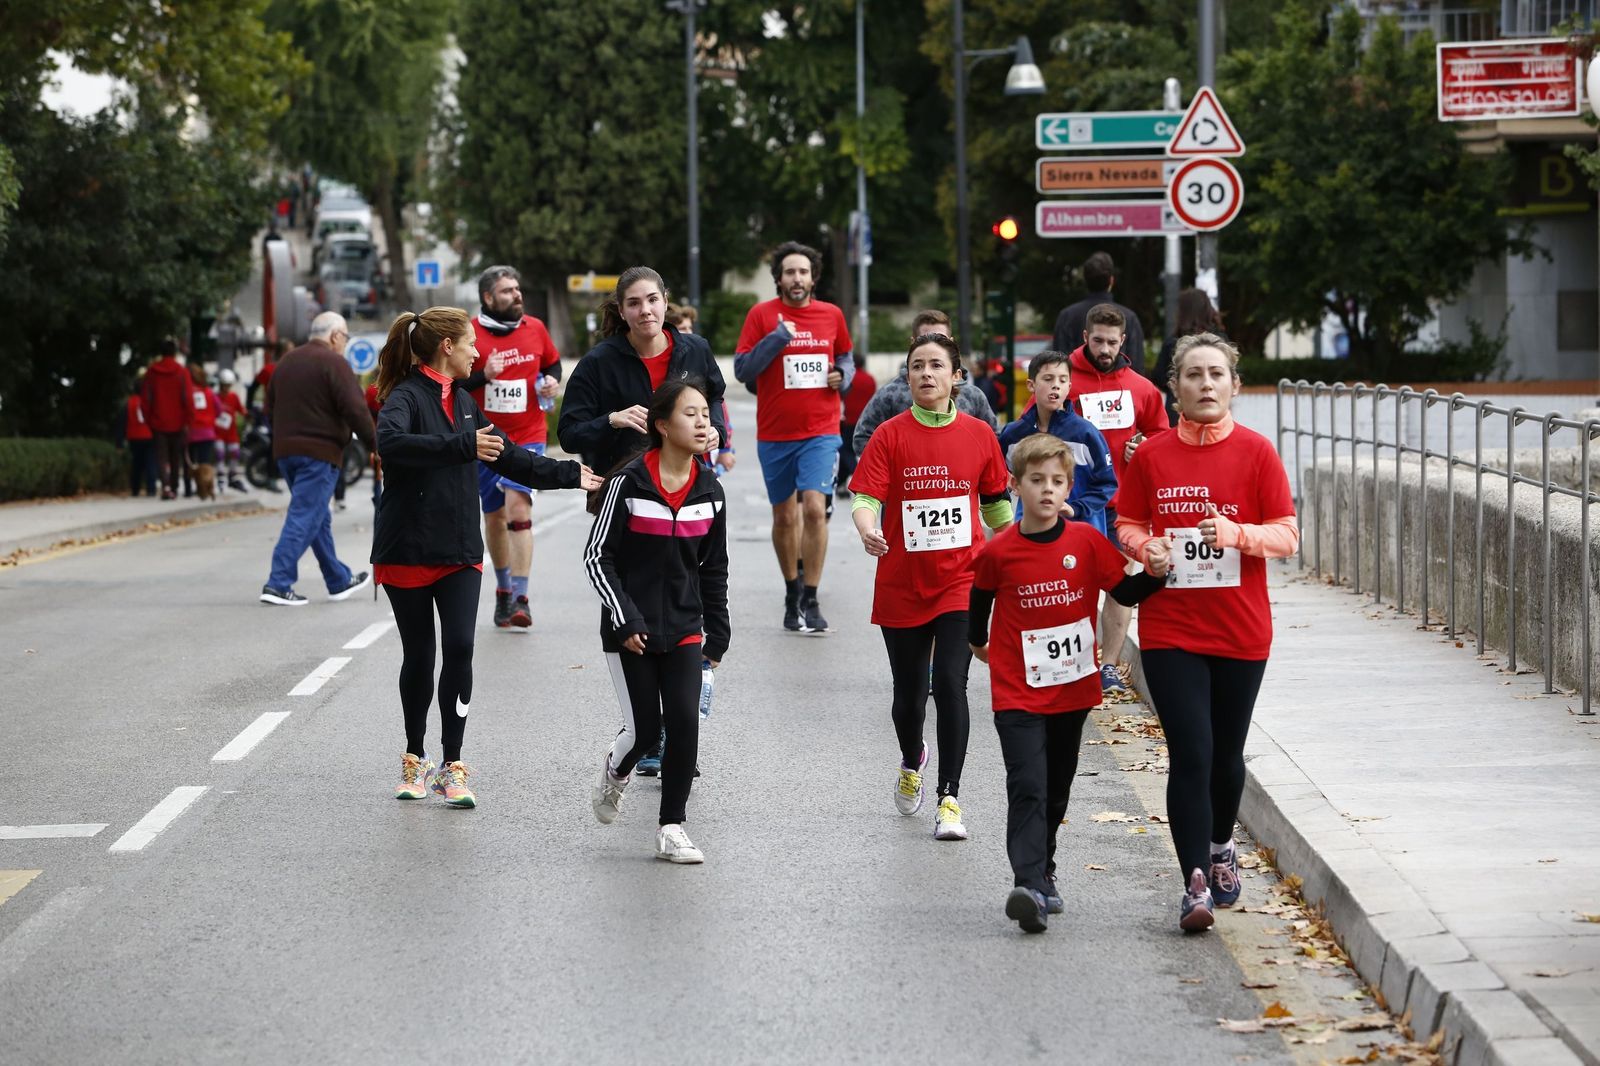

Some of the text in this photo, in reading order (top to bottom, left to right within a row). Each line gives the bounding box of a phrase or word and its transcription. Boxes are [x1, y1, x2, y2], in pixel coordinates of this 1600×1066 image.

[1046, 167, 1157, 182] Sierra Nevada
[1541, 155, 1574, 196] B
[1187, 183, 1224, 204] 30
[1045, 212, 1123, 226] Alhambra
[793, 362, 822, 373] 1058
[494, 387, 522, 398] 1148
[1097, 400, 1122, 412] 198
[903, 465, 949, 477] carrera
[904, 476, 971, 492] cruzroja.es
[1157, 485, 1210, 499] carrera
[917, 507, 962, 528] 1215
[1184, 541, 1224, 561] 909
[1197, 562, 1214, 571] SILVIA
[1018, 579, 1069, 596] carrera
[1020, 587, 1084, 609] cruzroja.e
[1047, 634, 1082, 660] 911
